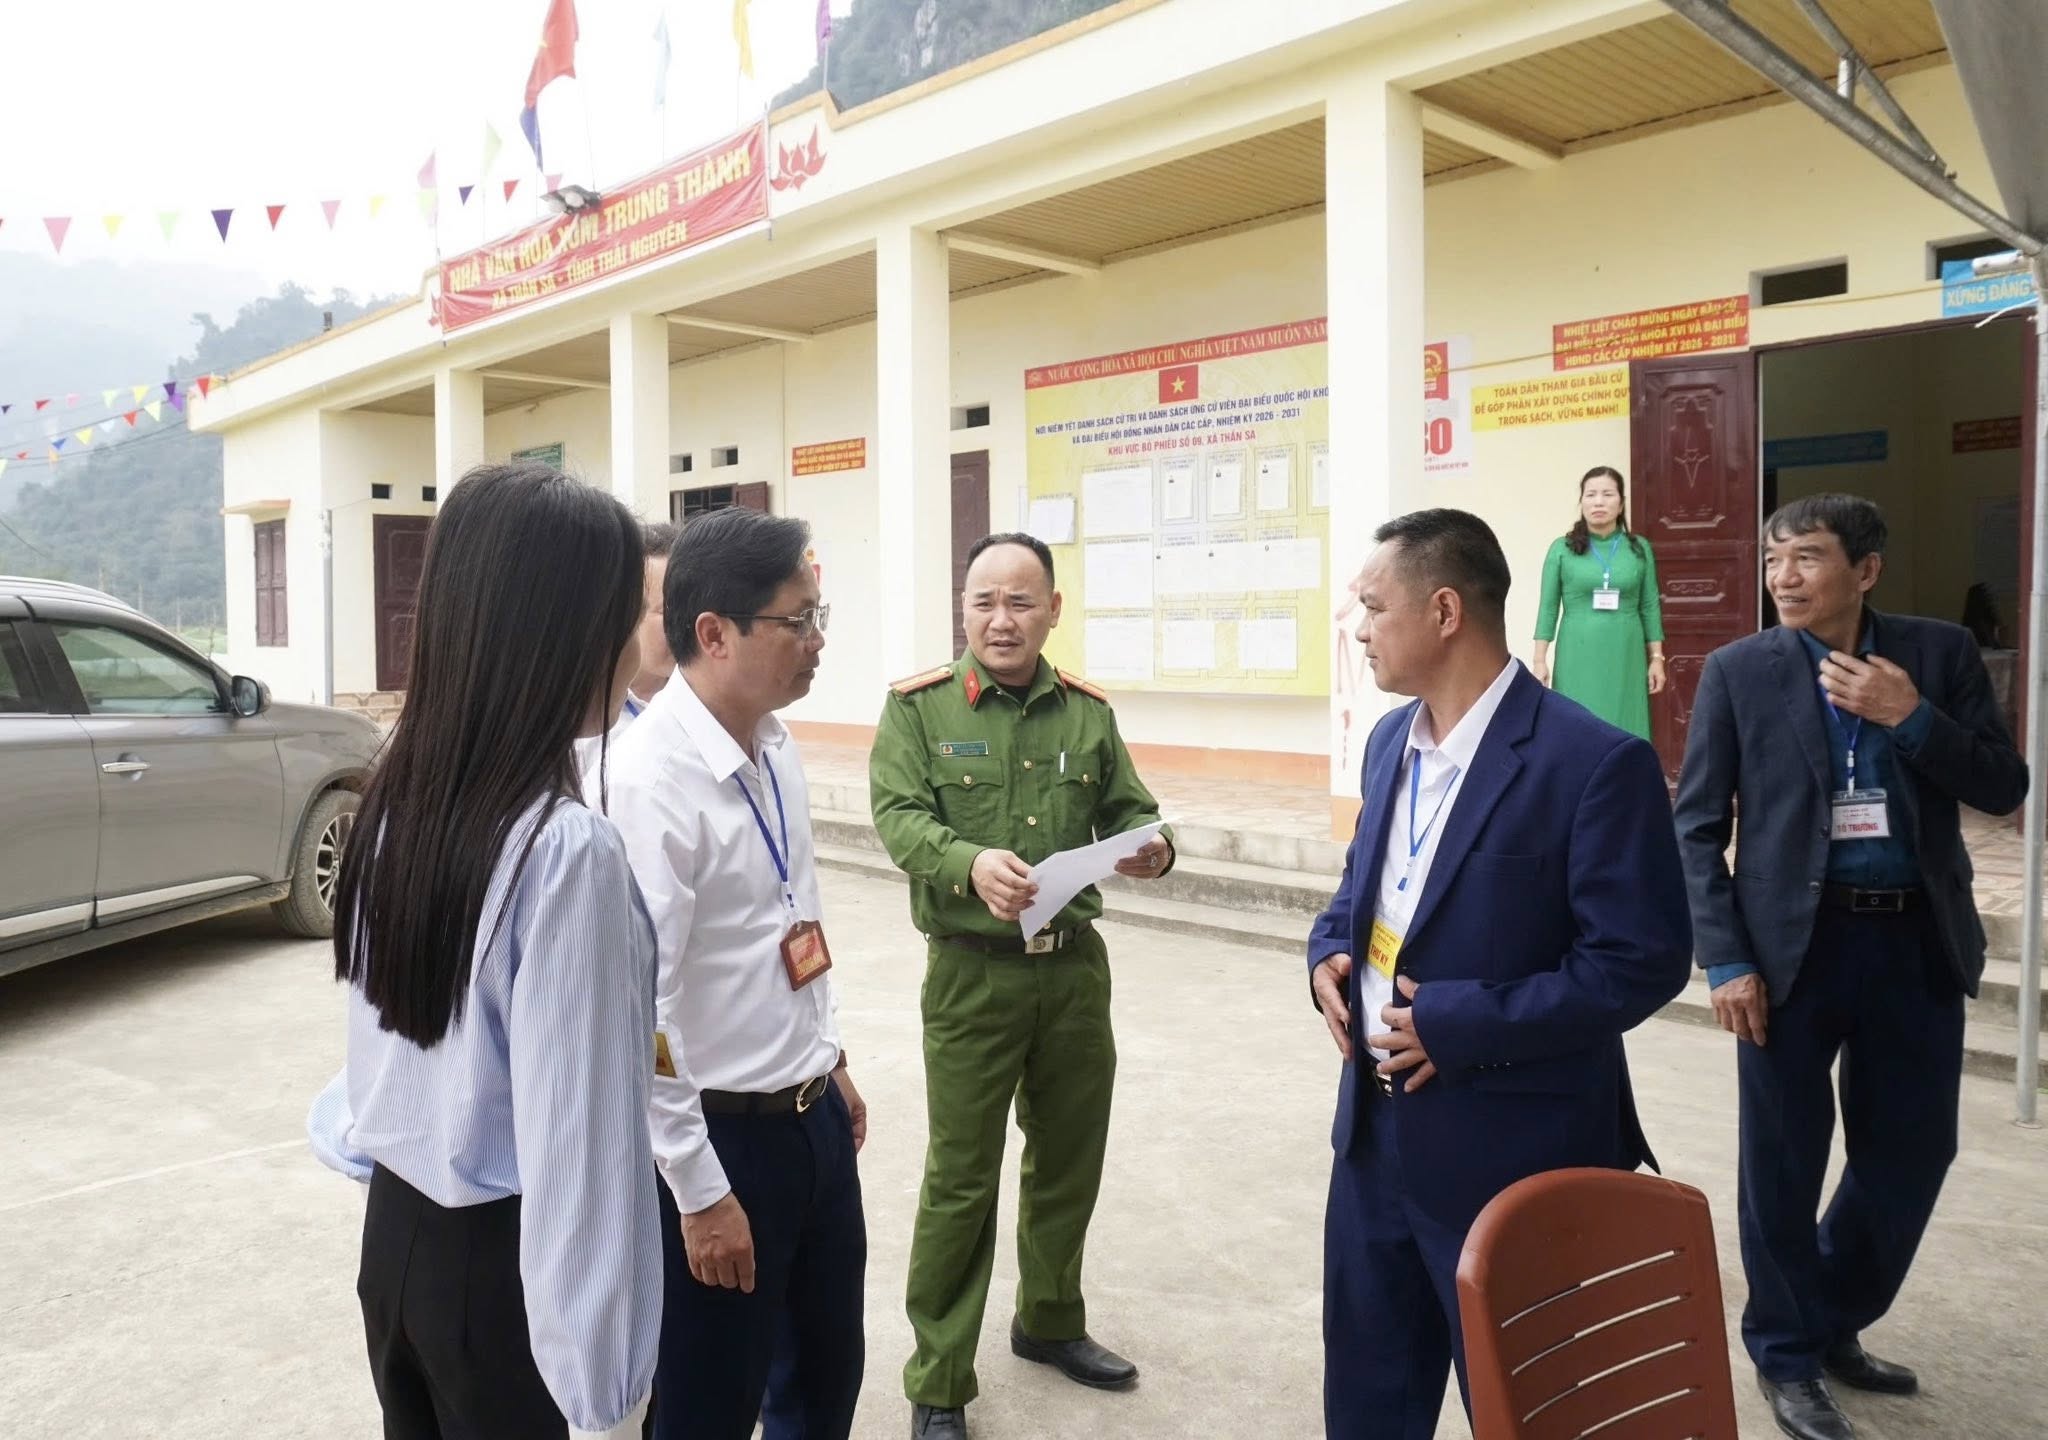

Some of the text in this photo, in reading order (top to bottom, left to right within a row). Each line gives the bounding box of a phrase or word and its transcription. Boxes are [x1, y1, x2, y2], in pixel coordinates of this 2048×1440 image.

[604, 182, 669, 235] TRUNG
[674, 144, 750, 204] THÀNH
[598, 240, 626, 271] THÁI
[630, 219, 688, 261] NGUYÊN
[1947, 279, 2030, 308] XỨNG ĐÁNG
[1564, 322, 1590, 338] NHIỆT
[1592, 319, 1610, 334] LIỆT
[1612, 313, 1637, 332] CHÀO
[1640, 308, 1670, 327] MỪNG
[1672, 304, 1699, 322] NGÀY
[1641, 325, 1668, 342] KHÓA
[1670, 324, 1686, 338] XVI
[1688, 319, 1701, 335] VÀ
[1703, 318, 1722, 333] ĐẠI
[1724, 311, 1746, 329] BIỂU
[1074, 361, 1100, 379] CỘNG
[1101, 354, 1120, 374] HÒA
[1120, 352, 1135, 370] XÃ
[1137, 351, 1155, 370] HỘI
[1180, 340, 1213, 361] NGHĨA
[1213, 337, 1238, 357] VIỆT
[1240, 333, 1265, 350] NAM
[1267, 324, 1300, 345] MUÔN
[1593, 349, 1611, 364] CÁC
[1613, 344, 1631, 361] CẤP
[1632, 340, 1664, 358] NHIỆM
[1666, 337, 1678, 352] KỲ
[1680, 337, 1702, 351] 2026
[1711, 333, 1736, 347] 2031!
[1475, 386, 1630, 415] ĐỂ GÓP PHẦN XÂY DỰNG CHÍNH QU
[1494, 371, 1623, 399] TOÀN DÂN THAM GIA BẦU CỬ
[1078, 418, 1095, 430] DANH
[1096, 415, 1114, 428] SÁCH
[1115, 412, 1125, 425] CỬ
[1126, 412, 1137, 423] TRI
[1138, 410, 1148, 422] VÀ
[1149, 408, 1168, 420] DANH
[1170, 404, 1188, 417] SÁCH
[1190, 400, 1205, 415] ỨNG
[1207, 399, 1217, 412] CỬ
[1219, 396, 1237, 411] VIÊN
[1254, 392, 1272, 407] BIỂU
[1273, 389, 1295, 405] QUỐC
[1297, 388, 1311, 402] HỘI
[1313, 385, 1329, 398] KHÓ
[1498, 403, 1619, 427] TRONG SẠCH, VỮNG MẠNH!
[1072, 433, 1081, 444] VÀ
[1094, 430, 1109, 442] BIỂU
[1110, 429, 1121, 441] HỘI
[1123, 426, 1141, 438] ĐỒNG
[1143, 424, 1163, 437] NHÂN
[1164, 420, 1179, 433] DÂN
[1181, 417, 1195, 431] CÁC
[1216, 412, 1242, 428] NHIỆM
[1243, 410, 1253, 423] KỲ
[1255, 410, 1274, 422] 2026
[1281, 407, 1300, 419] 2031
[1108, 445, 1124, 456] KHU
[1125, 442, 1139, 454] VỰC
[1154, 435, 1178, 450] PHIẾU
[1179, 433, 1190, 448] SỐ
[1207, 431, 1218, 444] XÃ
[1244, 429, 1256, 440] SA
